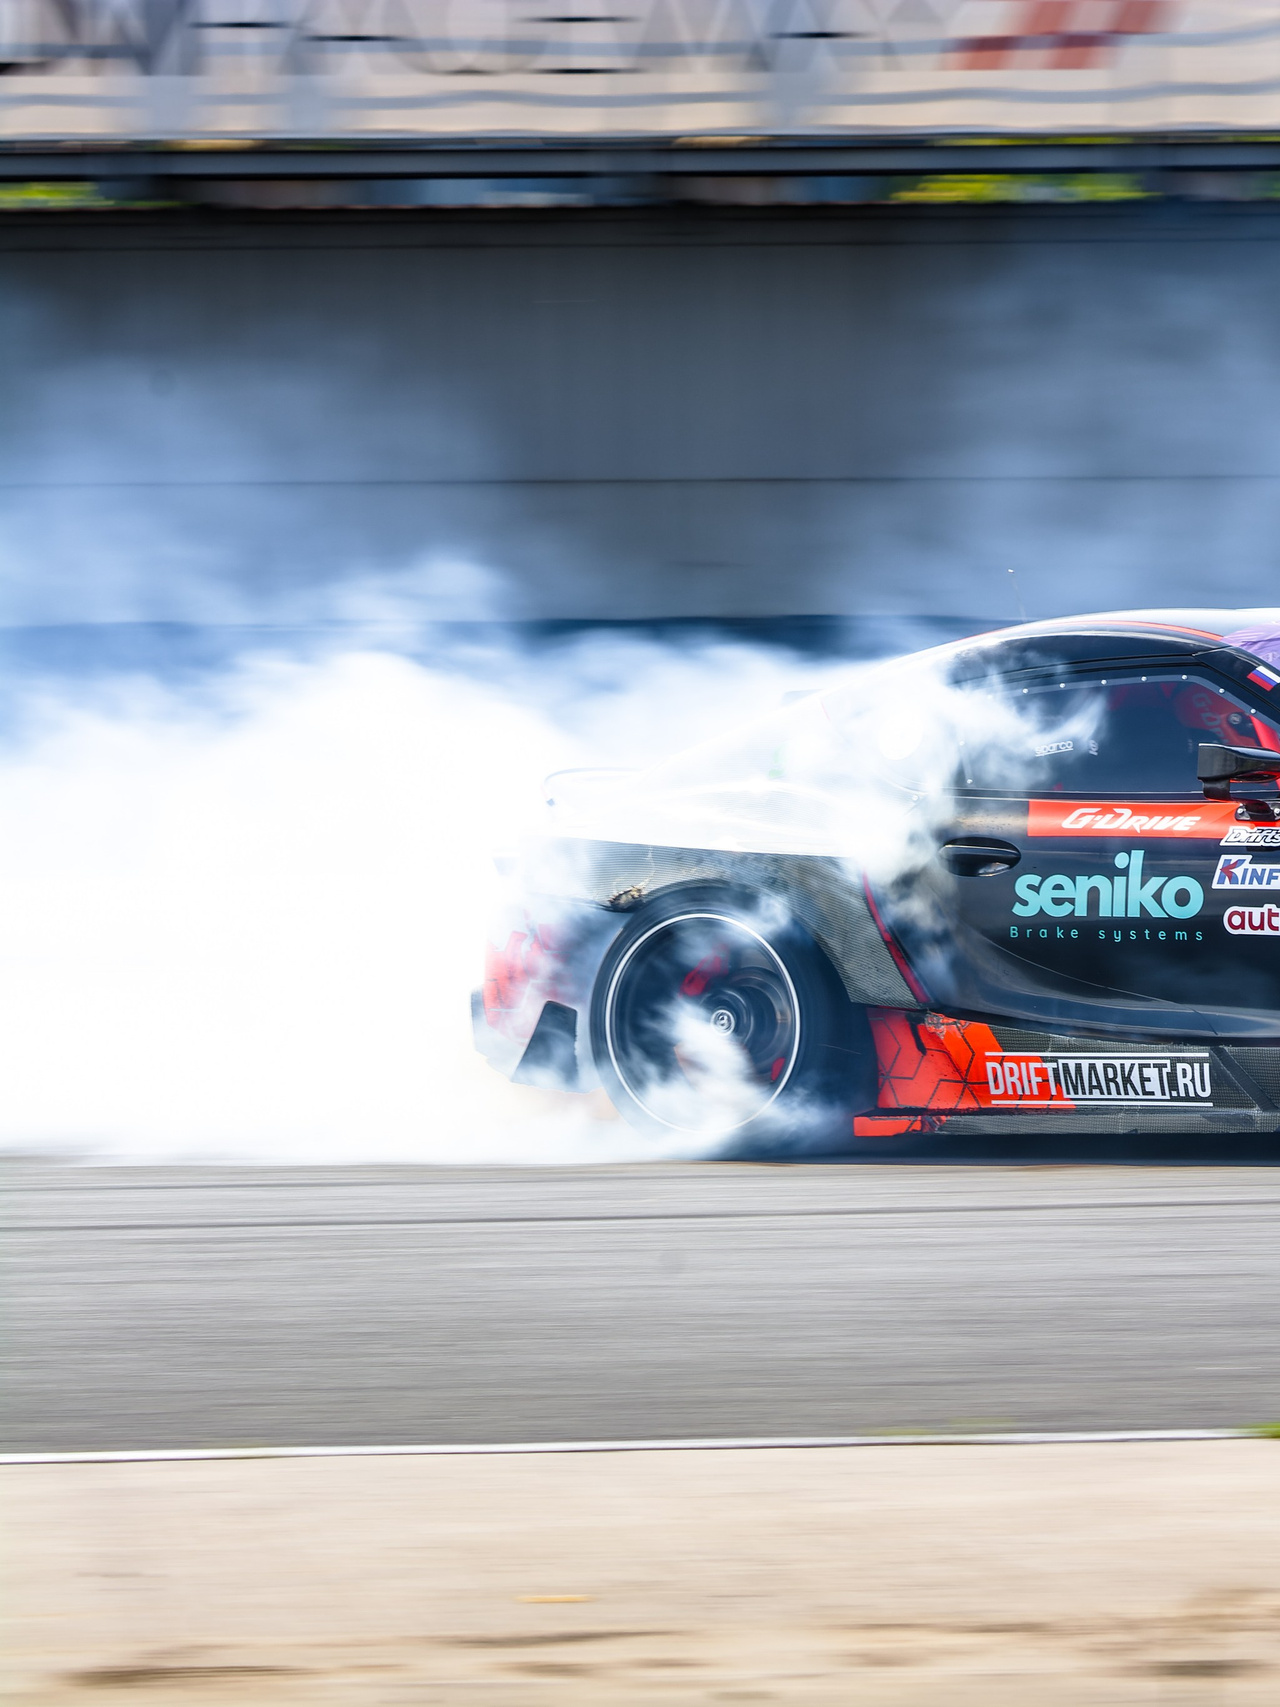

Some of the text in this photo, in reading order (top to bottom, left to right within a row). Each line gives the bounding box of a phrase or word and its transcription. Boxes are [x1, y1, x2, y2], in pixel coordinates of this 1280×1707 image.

[1035, 740, 1074, 755] sparco
[1011, 849, 1205, 920] seniko
[1009, 925, 1204, 942] Brake systems
[985, 1059, 1212, 1099] DRIFTMARKET.RU
